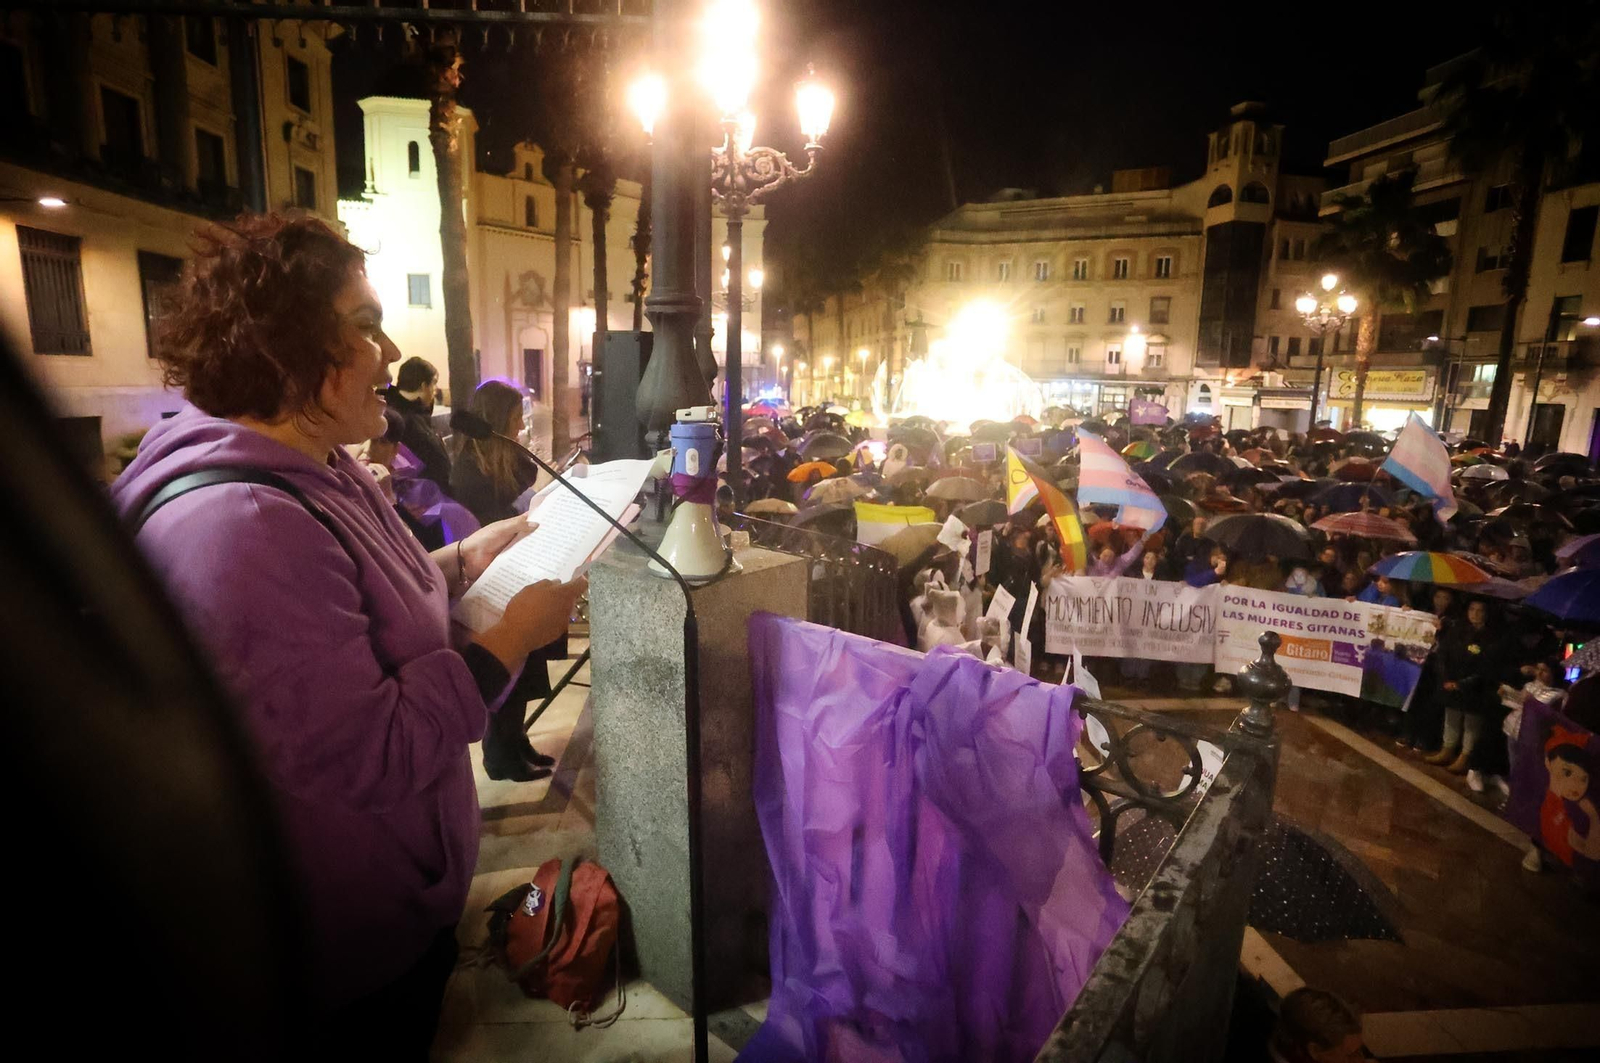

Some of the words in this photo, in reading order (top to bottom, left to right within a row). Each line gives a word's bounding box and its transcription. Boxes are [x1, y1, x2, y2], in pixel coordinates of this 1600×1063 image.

[1047, 595, 1132, 626] MOVIMIENTO
[1224, 595, 1249, 607] POR
[1251, 599, 1267, 610] LA
[1272, 601, 1339, 619] IGUALDAD
[1342, 611, 1361, 622] DE
[1222, 609, 1245, 621] LAS
[1247, 614, 1304, 630] MUJERES
[1306, 623, 1366, 639] GITANAS
[1286, 642, 1330, 660] Gitano
